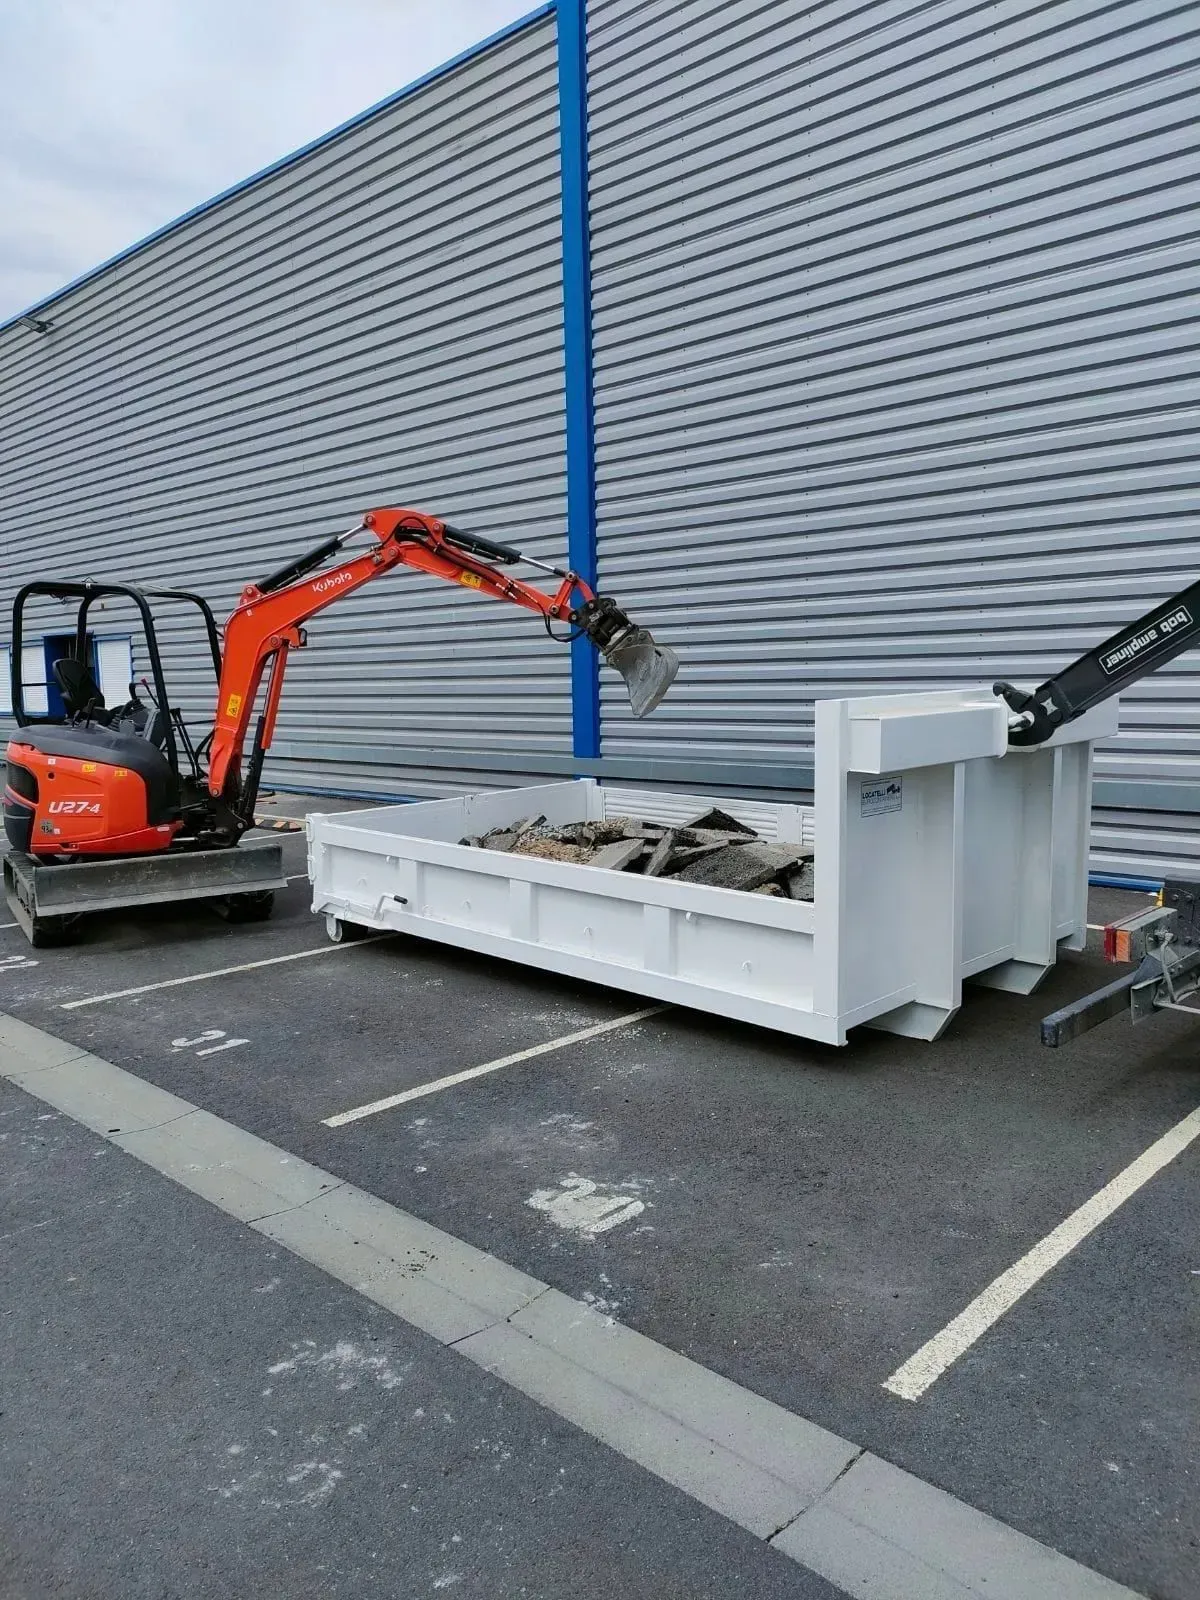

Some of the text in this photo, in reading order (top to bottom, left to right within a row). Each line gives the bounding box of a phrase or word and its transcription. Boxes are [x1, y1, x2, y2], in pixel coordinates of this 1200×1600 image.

[312, 572, 352, 592] Kubota
[1106, 611, 1188, 668] bob ampliner
[862, 787, 886, 799] LOCATELLI
[48, 801, 101, 814] U27-4
